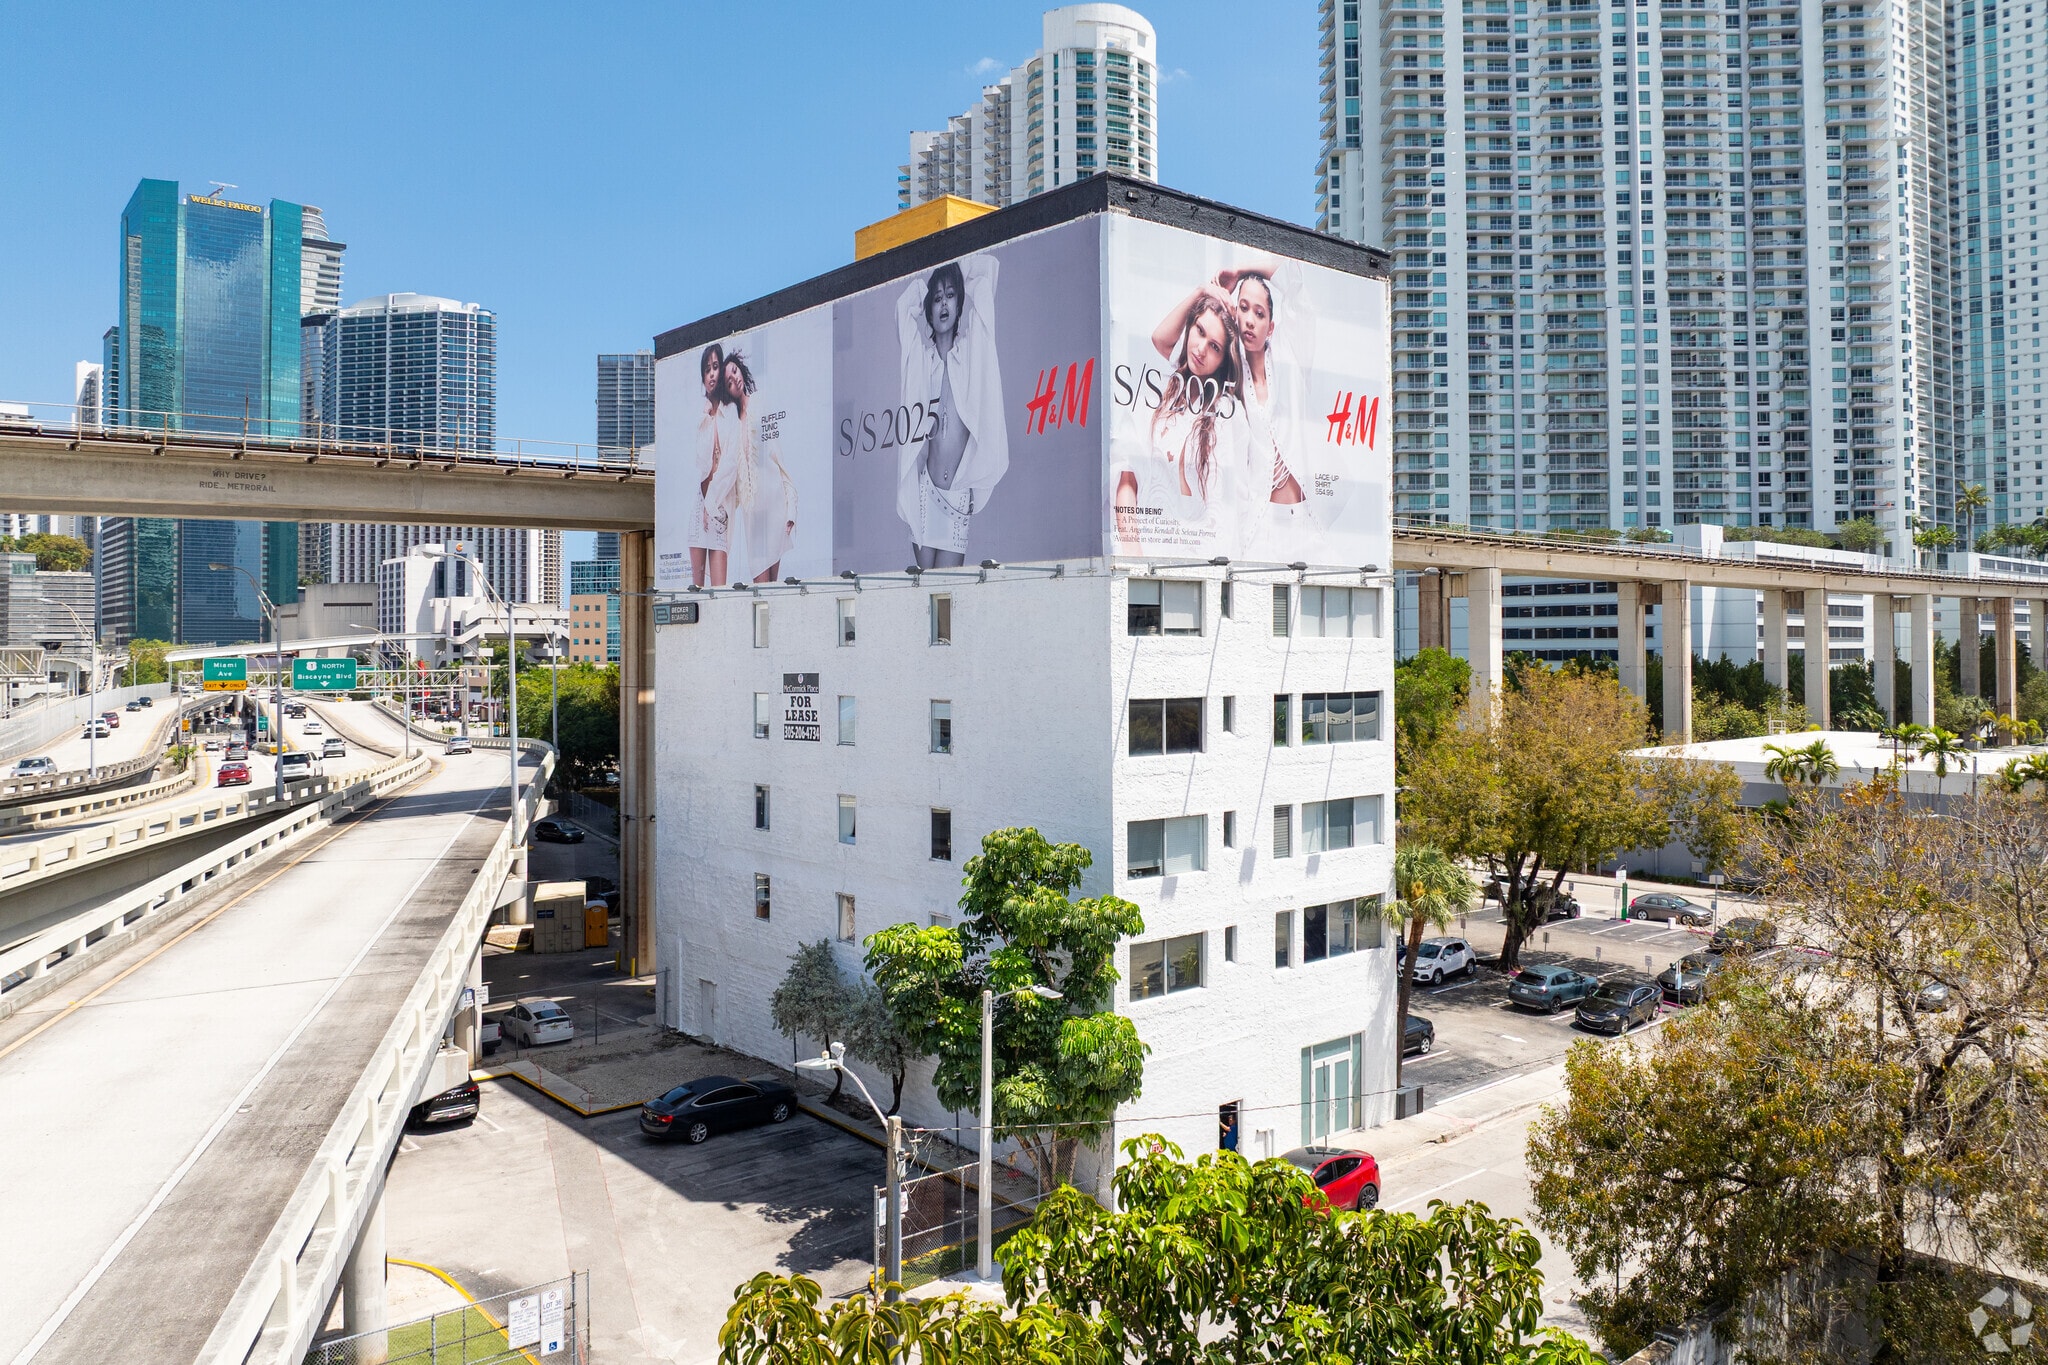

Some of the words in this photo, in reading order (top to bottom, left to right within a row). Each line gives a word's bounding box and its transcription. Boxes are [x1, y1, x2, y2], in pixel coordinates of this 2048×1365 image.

[190, 194, 226, 207] WELLS
[227, 201, 262, 213] FARGO
[1025, 357, 1095, 435] H&M
[1114, 363, 1164, 412] S/S
[1164, 374, 1237, 419] 2025
[761, 410, 787, 424] RUFFLED
[1326, 390, 1380, 451] H&M
[761, 421, 778, 433] TUNIC
[839, 409, 877, 460] S/S
[880, 397, 941, 450] 2025
[212, 470, 231, 478] WHY
[234, 472, 266, 481] DRIVE?
[227, 482, 277, 493] METRORAIL
[1135, 506, 1144, 515] ON
[1128, 516, 1148, 526] Project
[1114, 534, 1140, 543] Available
[1162, 536, 1173, 544] and
[297, 673, 332, 681] Biscayne
[790, 695, 812, 708] FOR
[785, 709, 818, 722] LEASE
[543, 1301, 553, 1310] LOT
